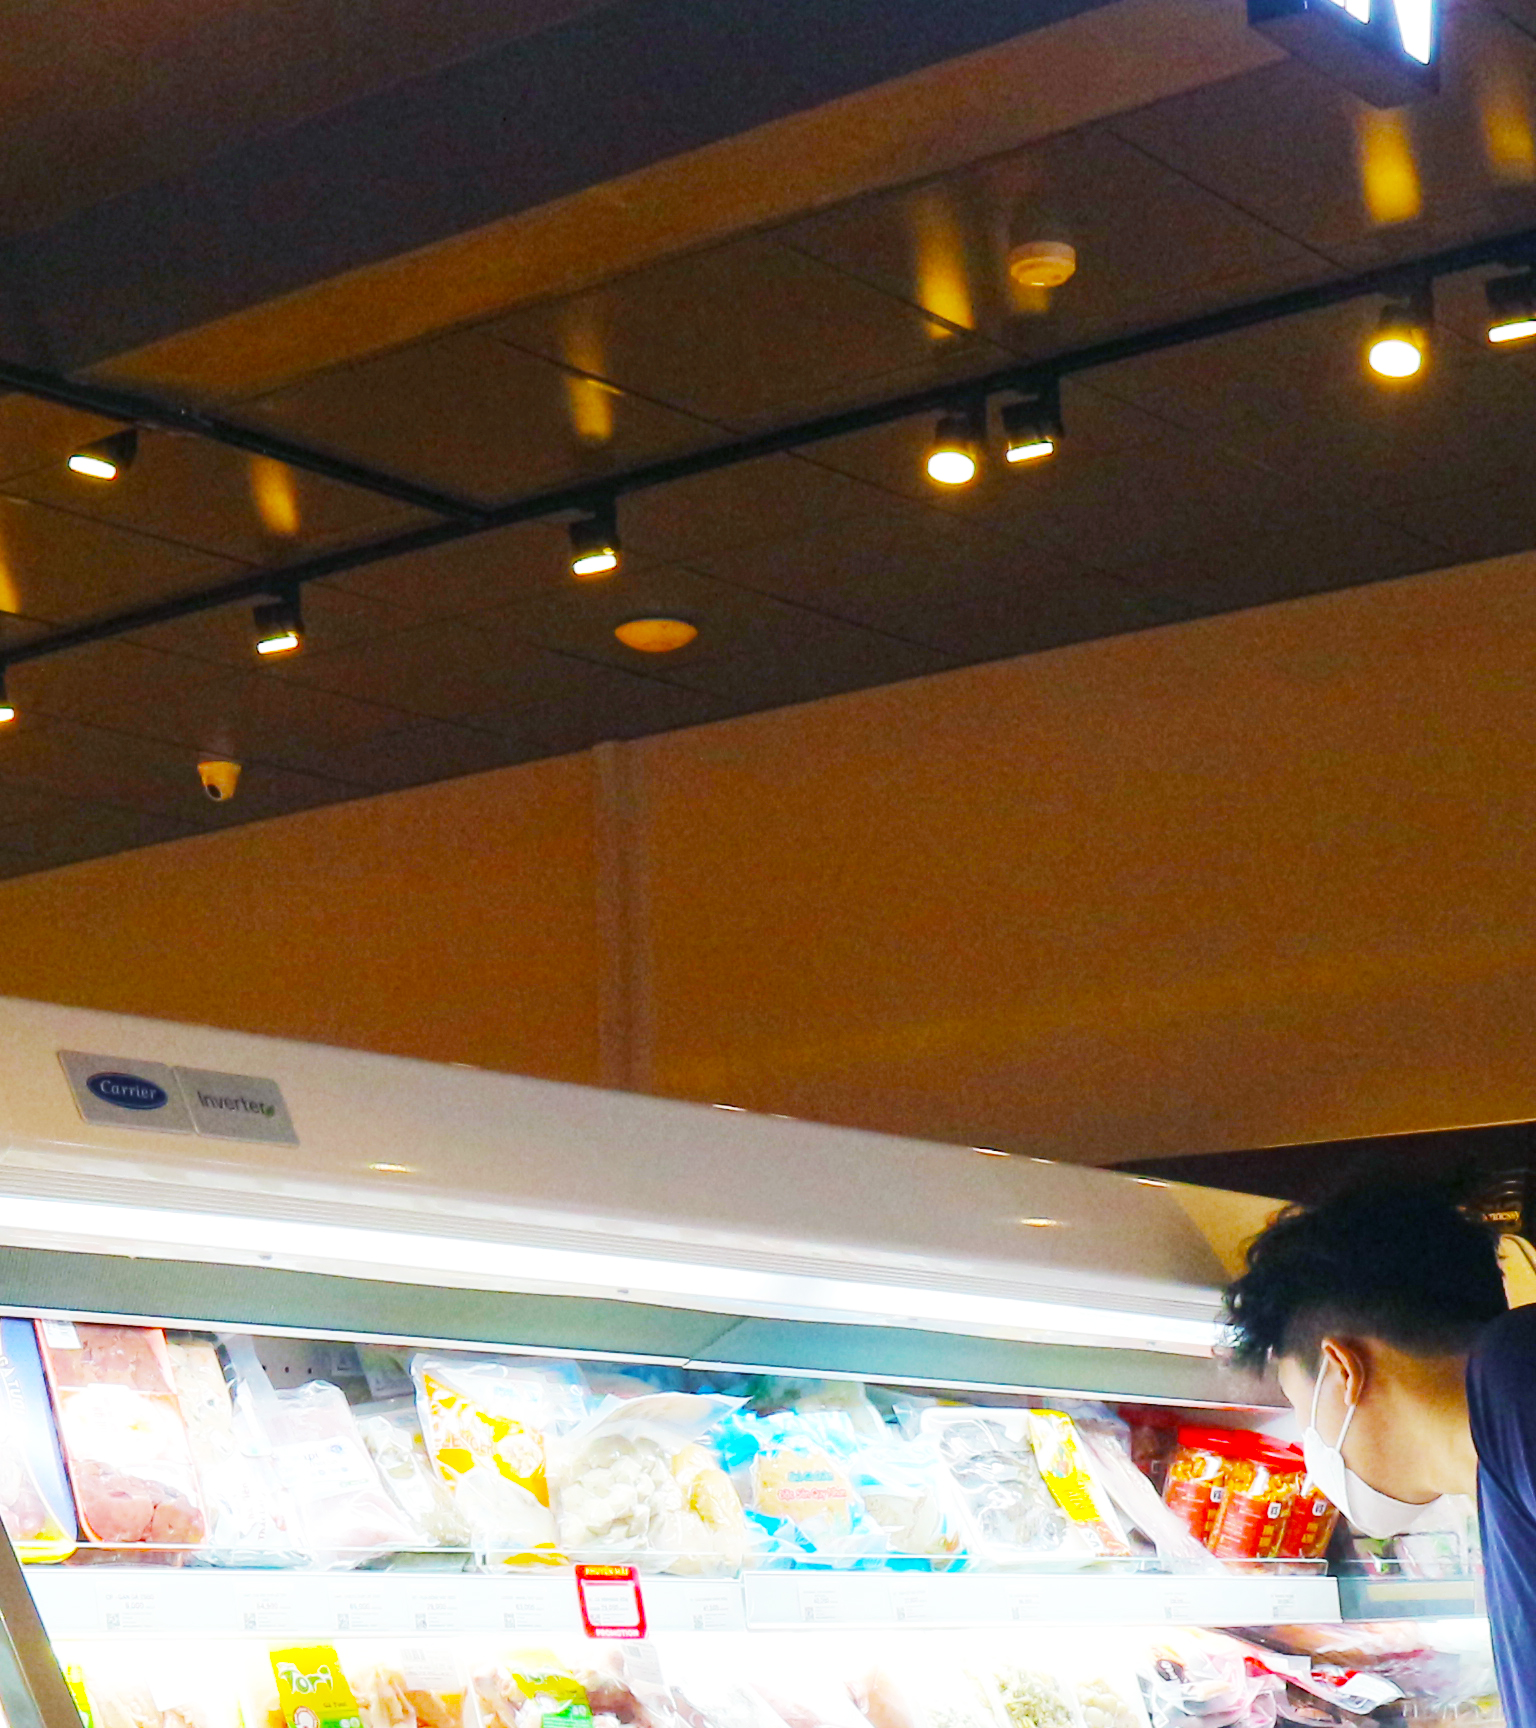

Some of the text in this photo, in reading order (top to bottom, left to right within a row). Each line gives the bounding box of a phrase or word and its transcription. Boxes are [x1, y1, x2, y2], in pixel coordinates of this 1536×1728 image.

[99, 1078, 159, 1101] Carrier
[197, 1090, 272, 1116] Inverter
[276, 1662, 333, 1694] Tori
